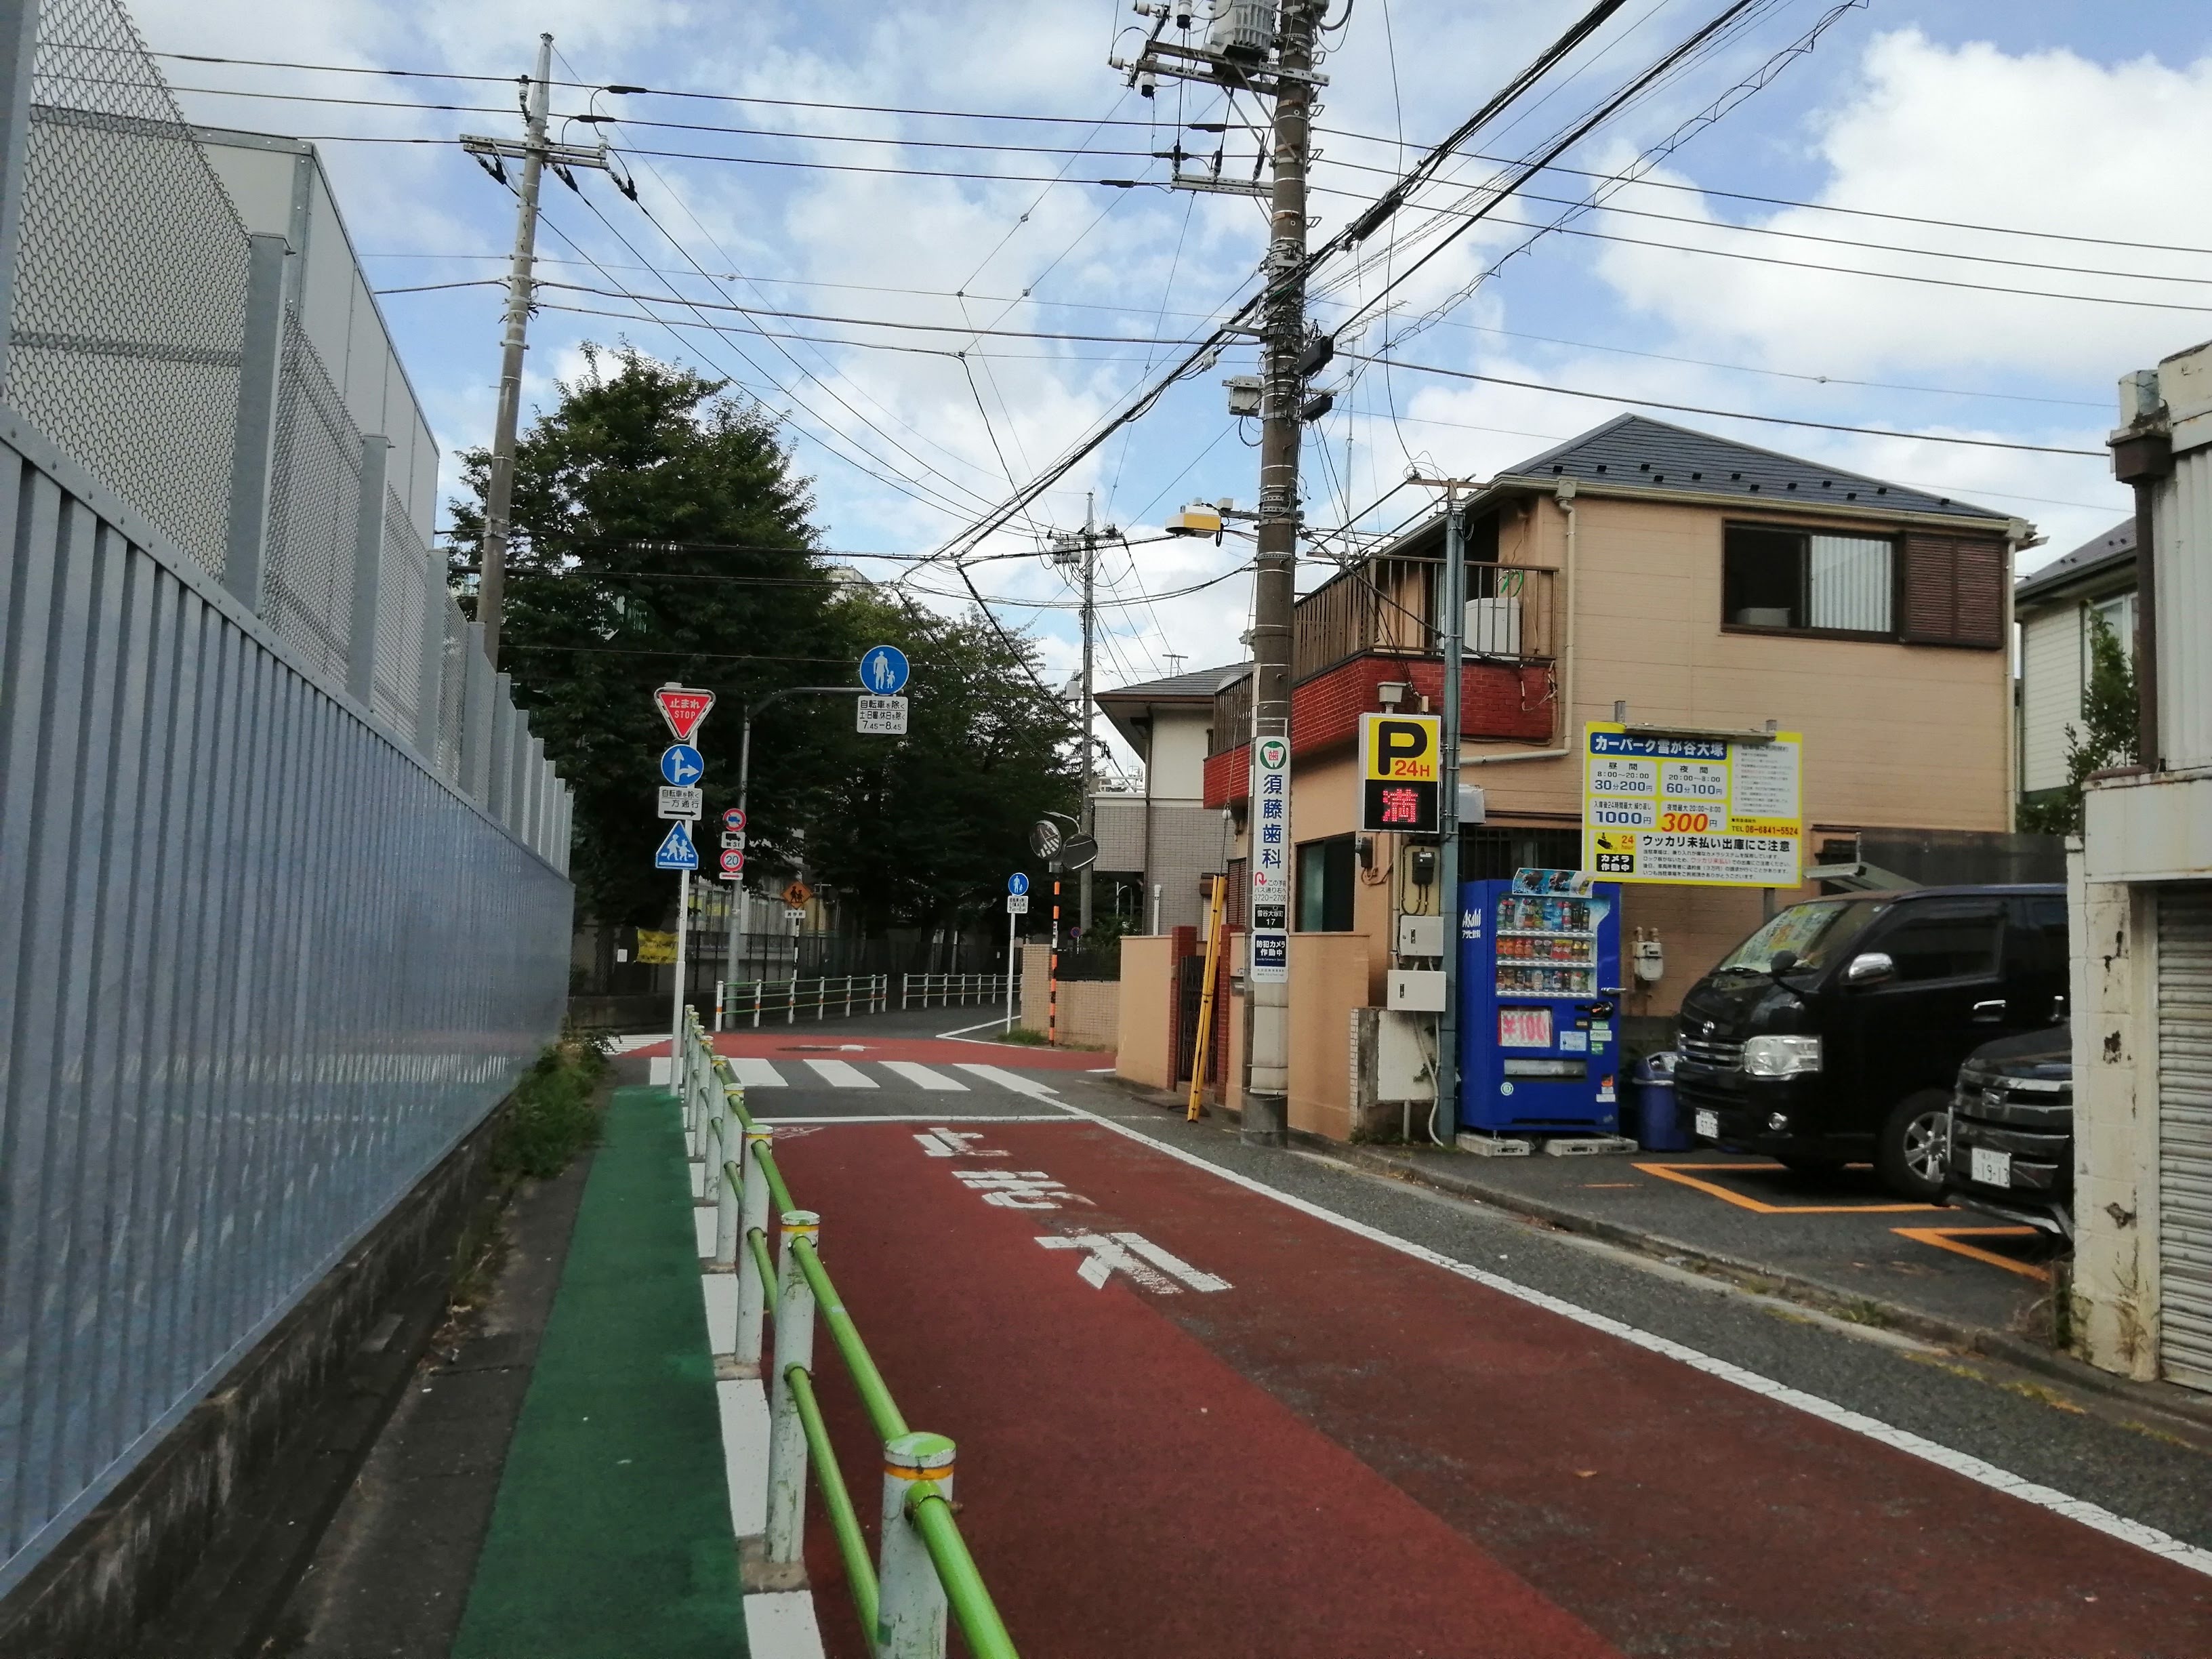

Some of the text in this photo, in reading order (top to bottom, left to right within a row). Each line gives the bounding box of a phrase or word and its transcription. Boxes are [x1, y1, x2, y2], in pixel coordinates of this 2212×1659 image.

[669, 698, 700, 709] 止まれ
[861, 699, 905, 709] 自転車を除く
[674, 710, 696, 719] STOP
[1378, 721, 1428, 776] P
[1595, 735, 1724, 757] カーパーク雪が谷大塚
[662, 789, 699, 799] 自転車を除く
[661, 800, 699, 808] 一方通行
[1262, 774, 1283, 869] 須藤歯科
[1622, 835, 1634, 844] 24
[1643, 835, 1790, 852] ウッカリ未払い出庫にご注意
[726, 855, 739, 865] 20
[1601, 855, 1630, 863] カメラ
[1601, 863, 1630, 872] 作動中
[1462, 908, 1481, 928] Asahi
[1256, 940, 1286, 948] 防犯カメラ
